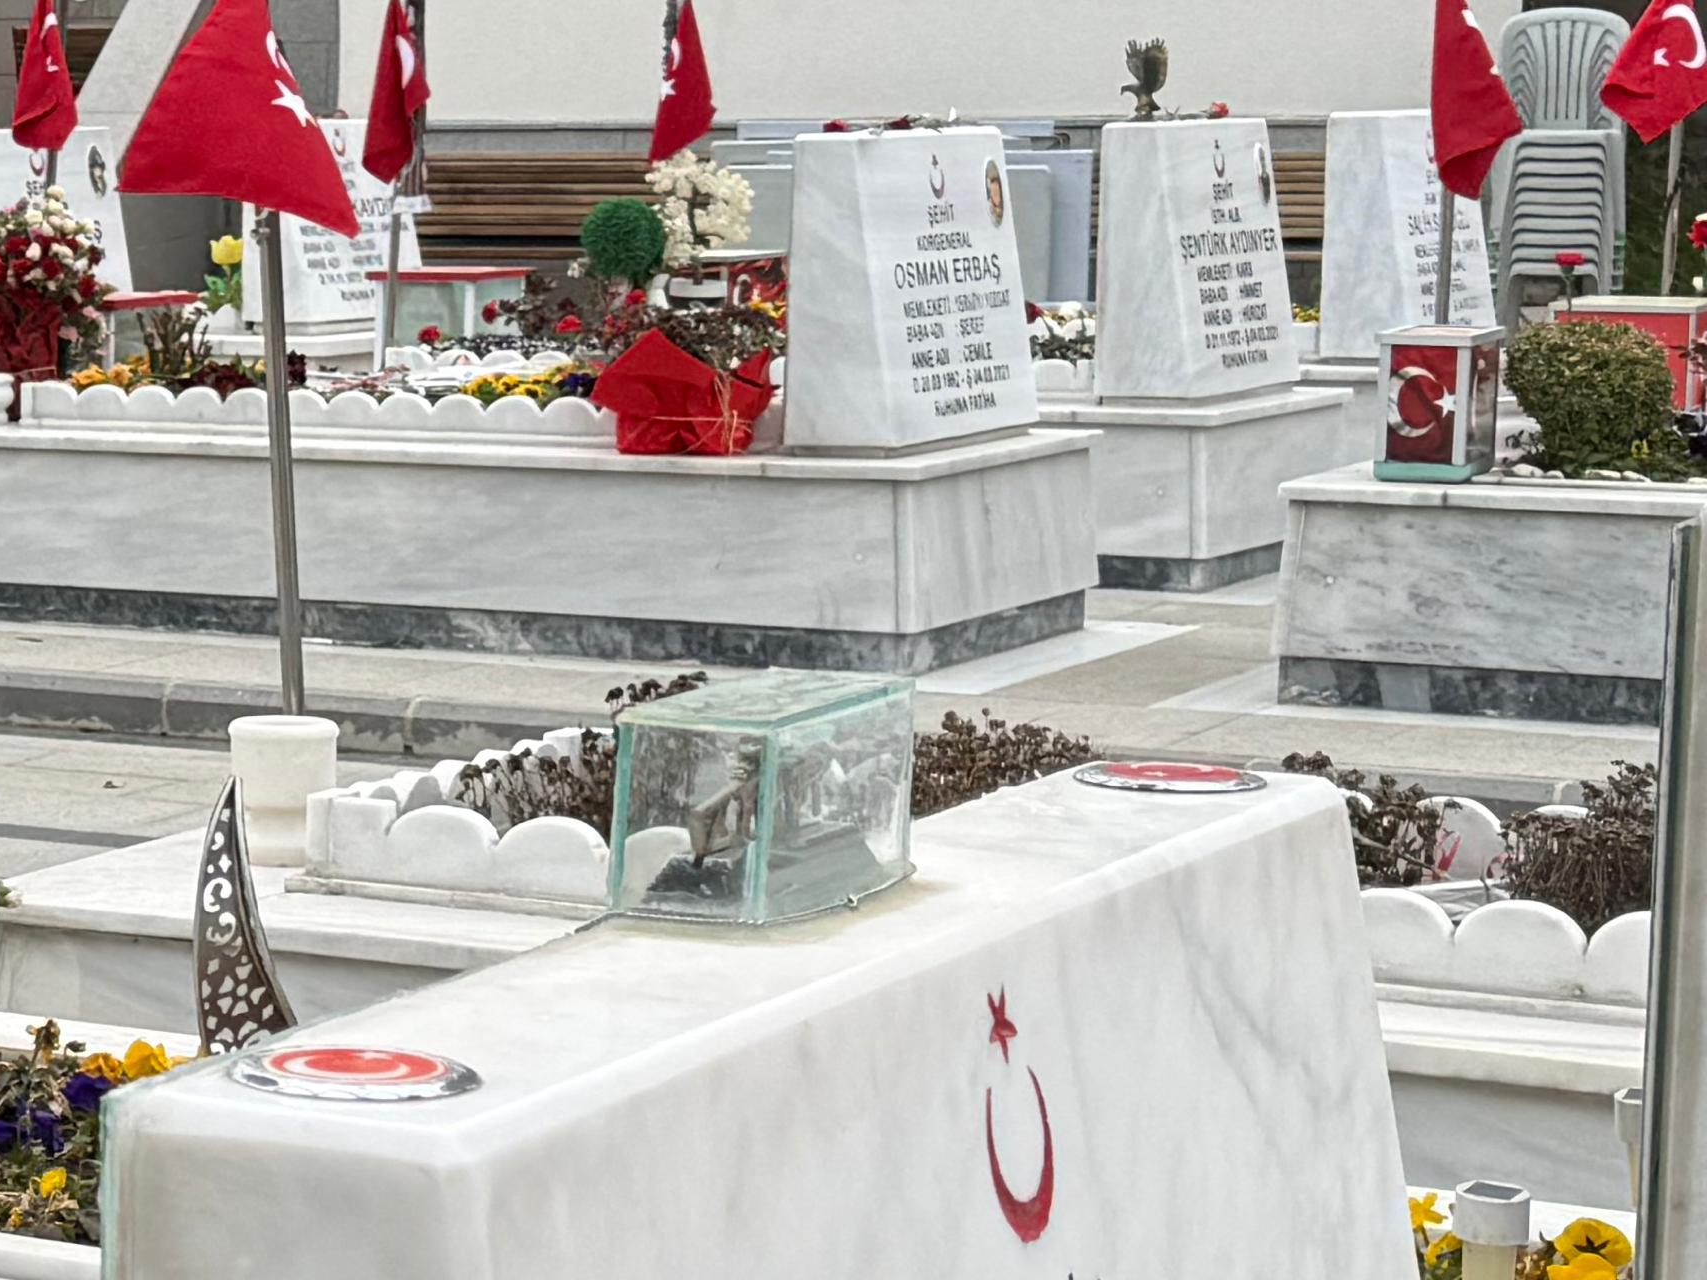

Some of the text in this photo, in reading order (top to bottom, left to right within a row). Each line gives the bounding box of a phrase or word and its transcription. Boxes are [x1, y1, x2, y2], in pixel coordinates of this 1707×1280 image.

[1180, 229, 1229, 265] ŞENTÜRK
[894, 252, 1001, 290] OSMAN ERBAŞ
